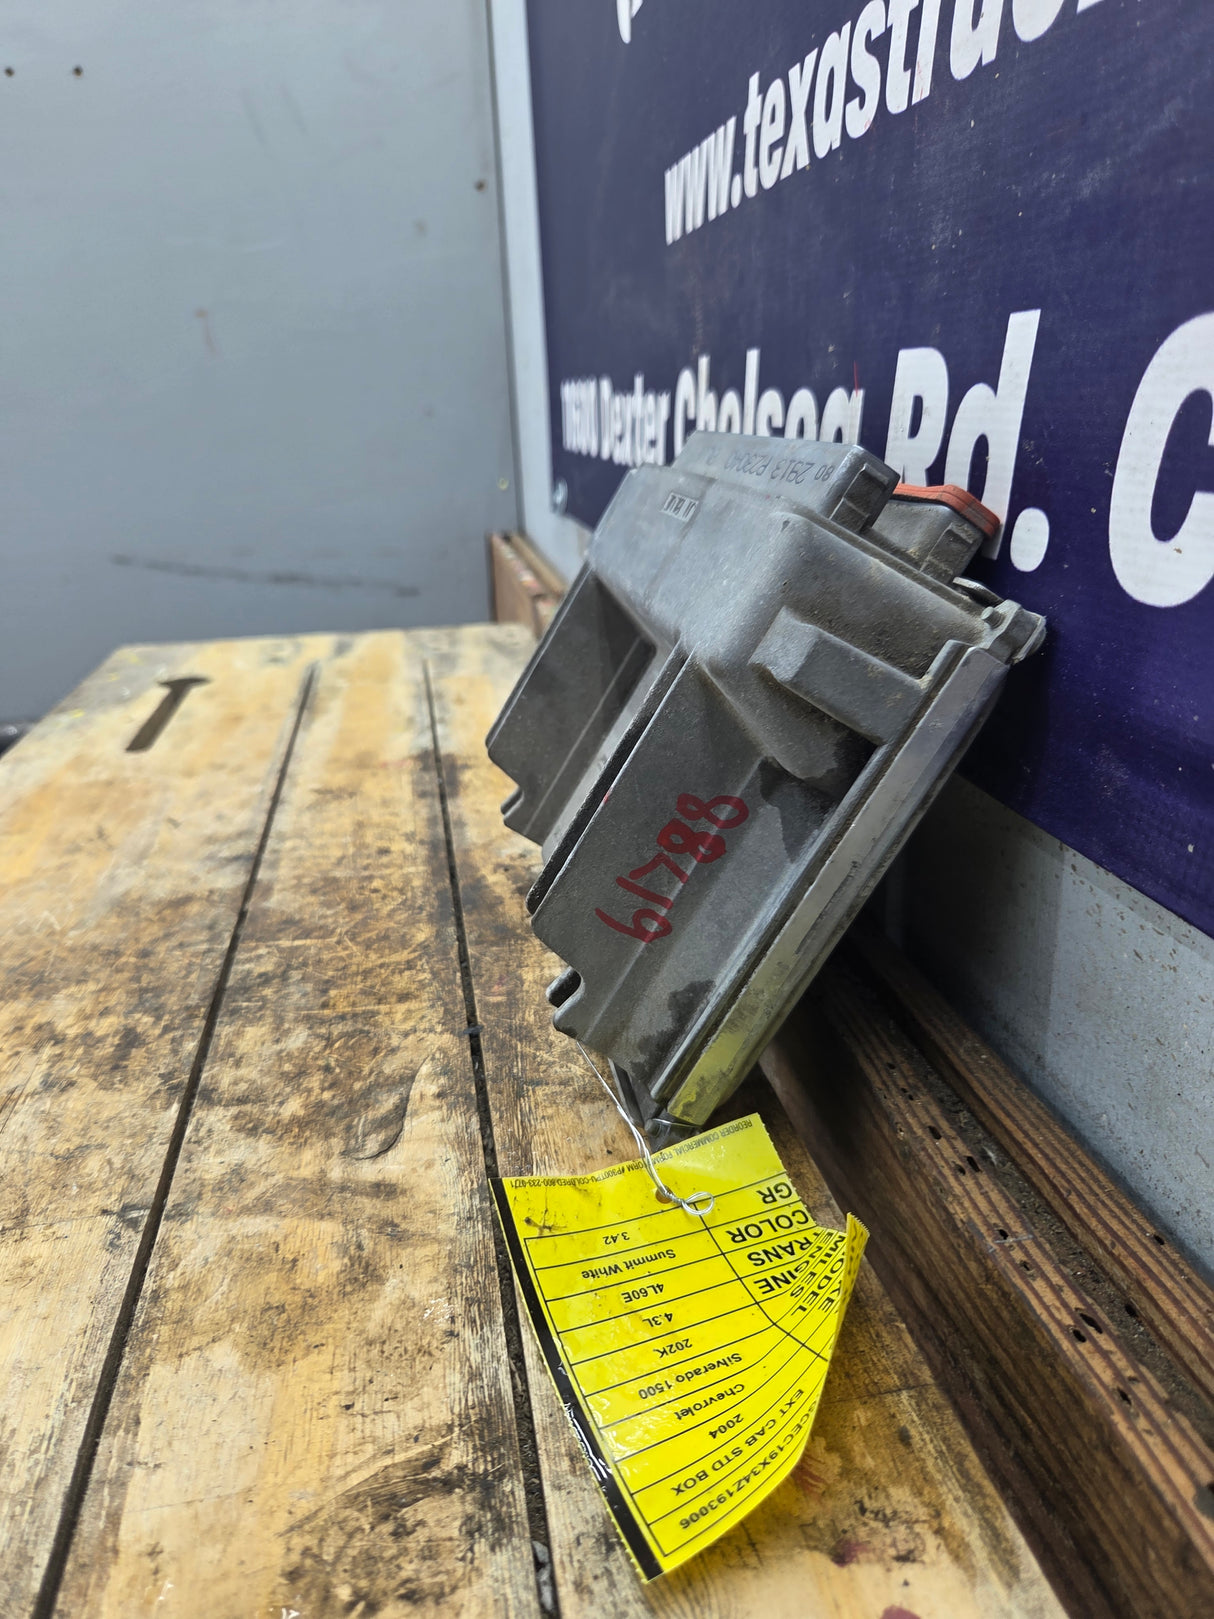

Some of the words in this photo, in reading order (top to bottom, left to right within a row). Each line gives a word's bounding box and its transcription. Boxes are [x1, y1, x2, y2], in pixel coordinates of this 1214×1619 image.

[665, 0, 1100, 246] www.texastru
[886, 308, 1050, 572] Rd.
[595, 793, 749, 943] 61788
[720, 1119, 753, 1138] REORDER
[674, 1133, 719, 1157] COMMERCIAL
[760, 1181, 793, 1206] GR
[602, 1230, 630, 1245] 3.42
[726, 1209, 809, 1244] COLOR
[622, 1248, 677, 1273] Summit
[747, 1231, 820, 1267] TRANS
[753, 1231, 834, 1295] ENGINE
[581, 1260, 623, 1280] White
[790, 1235, 846, 1298] MILES
[621, 1282, 665, 1304] 4L60E
[791, 1252, 845, 1316] ODEL
[642, 1311, 674, 1329] 4.3L
[652, 1337, 693, 1359] 202K
[675, 1352, 743, 1384] Silverado
[638, 1378, 673, 1401] 1500
[673, 1382, 746, 1422] Chevrolet
[779, 1388, 805, 1418] EXT
[708, 1412, 745, 1440] 2004
[744, 1418, 777, 1447] CAB
[679, 1392, 819, 1530] GCEC19X34Z193006
[711, 1446, 743, 1473] STD
[671, 1469, 710, 1497] BOX
